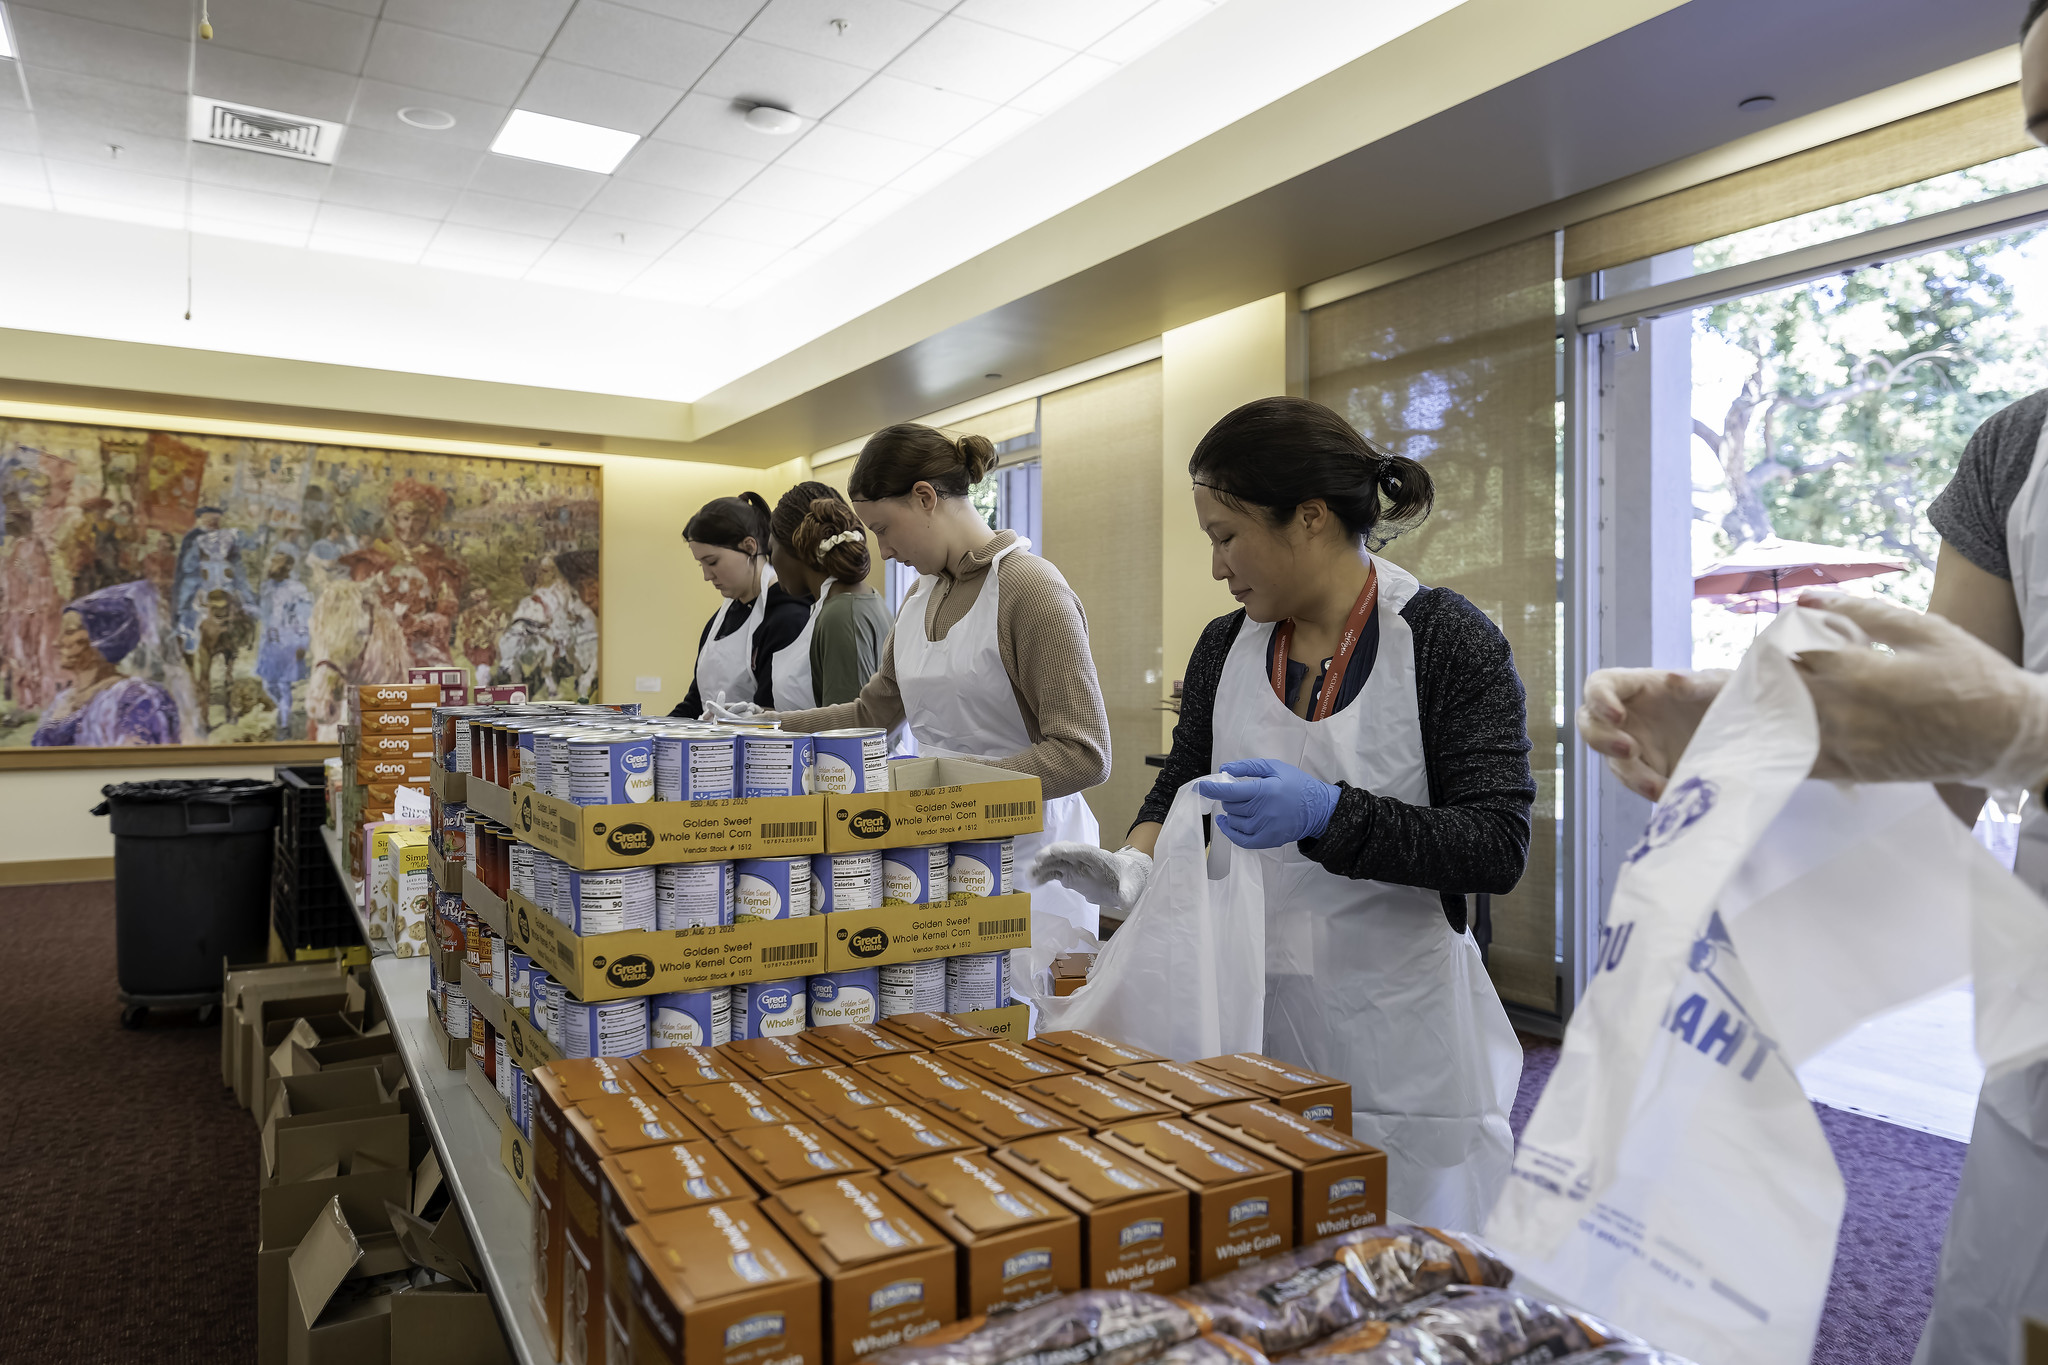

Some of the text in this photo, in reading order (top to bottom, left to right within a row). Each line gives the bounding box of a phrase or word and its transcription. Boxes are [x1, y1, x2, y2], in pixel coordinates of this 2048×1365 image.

[377, 689, 407, 701] dang
[379, 713, 409, 726] dang
[379, 738, 409, 751] dang
[626, 753, 647, 763] Great
[375, 763, 405, 775] dang
[821, 774, 846, 782] Kernel
[631, 778, 652, 789] Whole
[938, 787, 945, 795] 23
[948, 785, 962, 793] 2026
[721, 798, 729, 806] 23
[915, 800, 976, 813] Golden Sweet
[683, 817, 752, 828] Golden Sweet
[853, 816, 884, 828] Great
[895, 811, 977, 826] Whole Kernel Corn
[612, 831, 647, 843] Great
[660, 829, 751, 842] Whole Kernel Corn
[916, 828, 937, 836] Vendor
[621, 841, 647, 850] Value
[683, 846, 707, 854] Vendor
[405, 854, 428, 862] Simpl
[958, 876, 985, 884] Kernel
[892, 890, 912, 898] Corn
[744, 897, 771, 906] Kernel
[444, 899, 466, 922] Rip
[750, 906, 771, 914] Corn
[912, 917, 970, 930] Golden Sweet
[719, 925, 735, 933] 2026
[853, 934, 883, 947] Great
[892, 929, 970, 944] Whole Kernel Corn
[683, 942, 752, 957] Golden Sweet
[860, 944, 882, 952] Value
[912, 946, 933, 954] Vendor
[612, 962, 647, 975] Great
[660, 955, 752, 972] Whole Kernel Corn
[621, 973, 647, 982] Value
[683, 975, 707, 983] Vendor
[710, 972, 727, 980] Stock
[534, 982, 546, 990] Gre
[812, 983, 833, 992] Great
[762, 994, 787, 1004] Great
[840, 1000, 858, 1008] Golden
[768, 1002, 787, 1010] Value
[814, 1006, 870, 1016] Whole Kernel
[766, 1018, 793, 1028] Whole
[853, 1015, 870, 1023] Corn
[984, 1022, 1011, 1033] eet
[663, 1031, 692, 1039] Kernel
[1316, 1212, 1377, 1235] Whole Grain
[1216, 1233, 1281, 1260] Whole Grain
[1105, 1254, 1176, 1284] Whole Grain
[852, 1319, 940, 1355] Whole Grain
